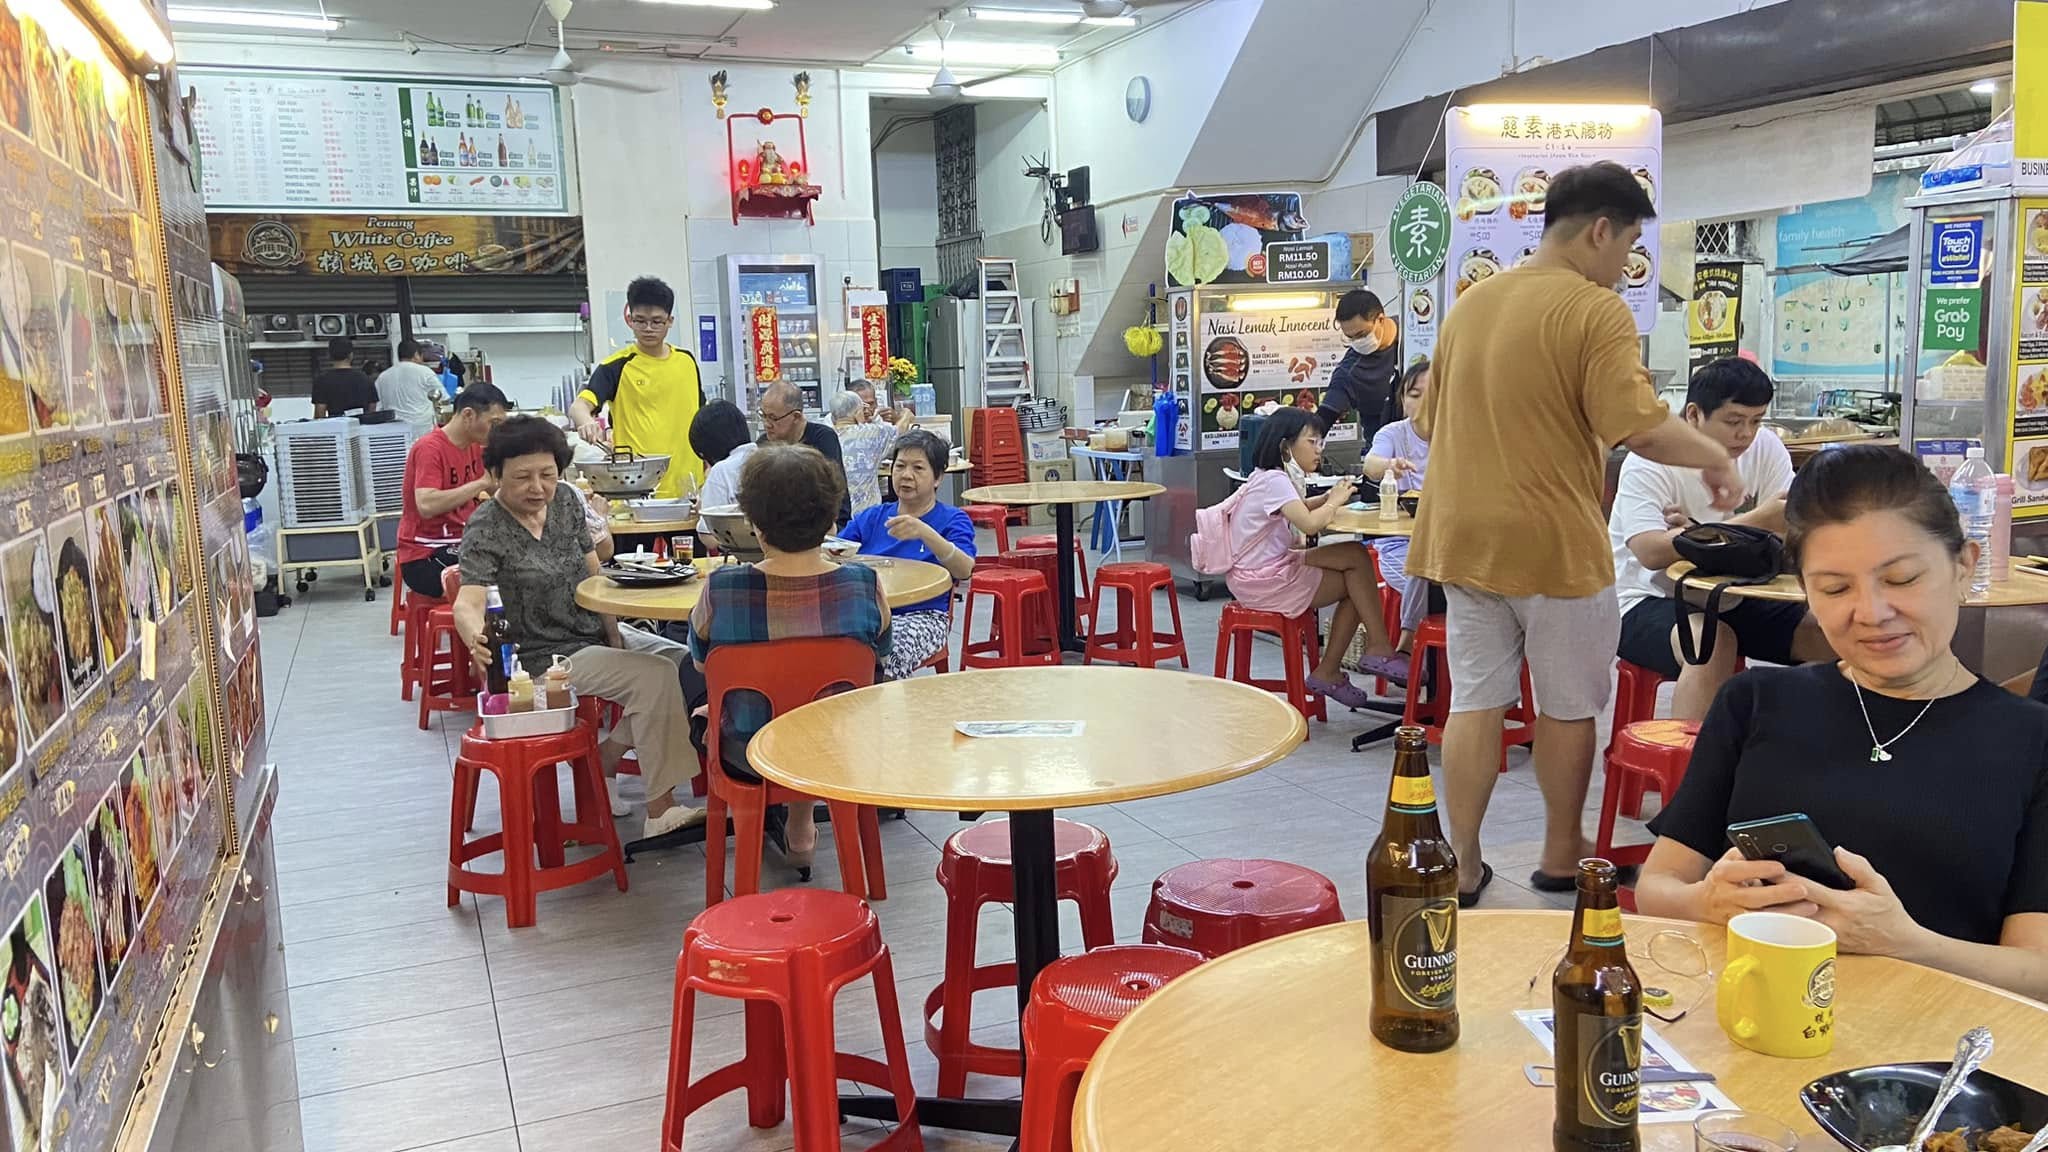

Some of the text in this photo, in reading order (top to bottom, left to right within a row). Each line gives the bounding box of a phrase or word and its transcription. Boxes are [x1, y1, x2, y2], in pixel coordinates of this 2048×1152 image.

[1394, 184, 1446, 212] VEGETARIAN
[366, 217, 415, 230] Penang
[1400, 204, 1440, 258] 素
[330, 231, 454, 249] White Coffee
[1780, 226, 1846, 243] family health
[1279, 252, 1318, 262] RM11.50
[1278, 270, 1320, 280] RM10.00
[1394, 256, 1443, 282] VEGETARIAN
[1948, 296, 1970, 306] prefer
[1934, 310, 1970, 324] Grab
[1208, 318, 1236, 336] Nasi
[1238, 318, 1278, 336] Lemak
[1279, 316, 1330, 332] Innocent
[1937, 326, 1965, 342] Pay
[2011, 496, 2026, 504] Grill
[1410, 967, 1444, 976] FOREIGN
